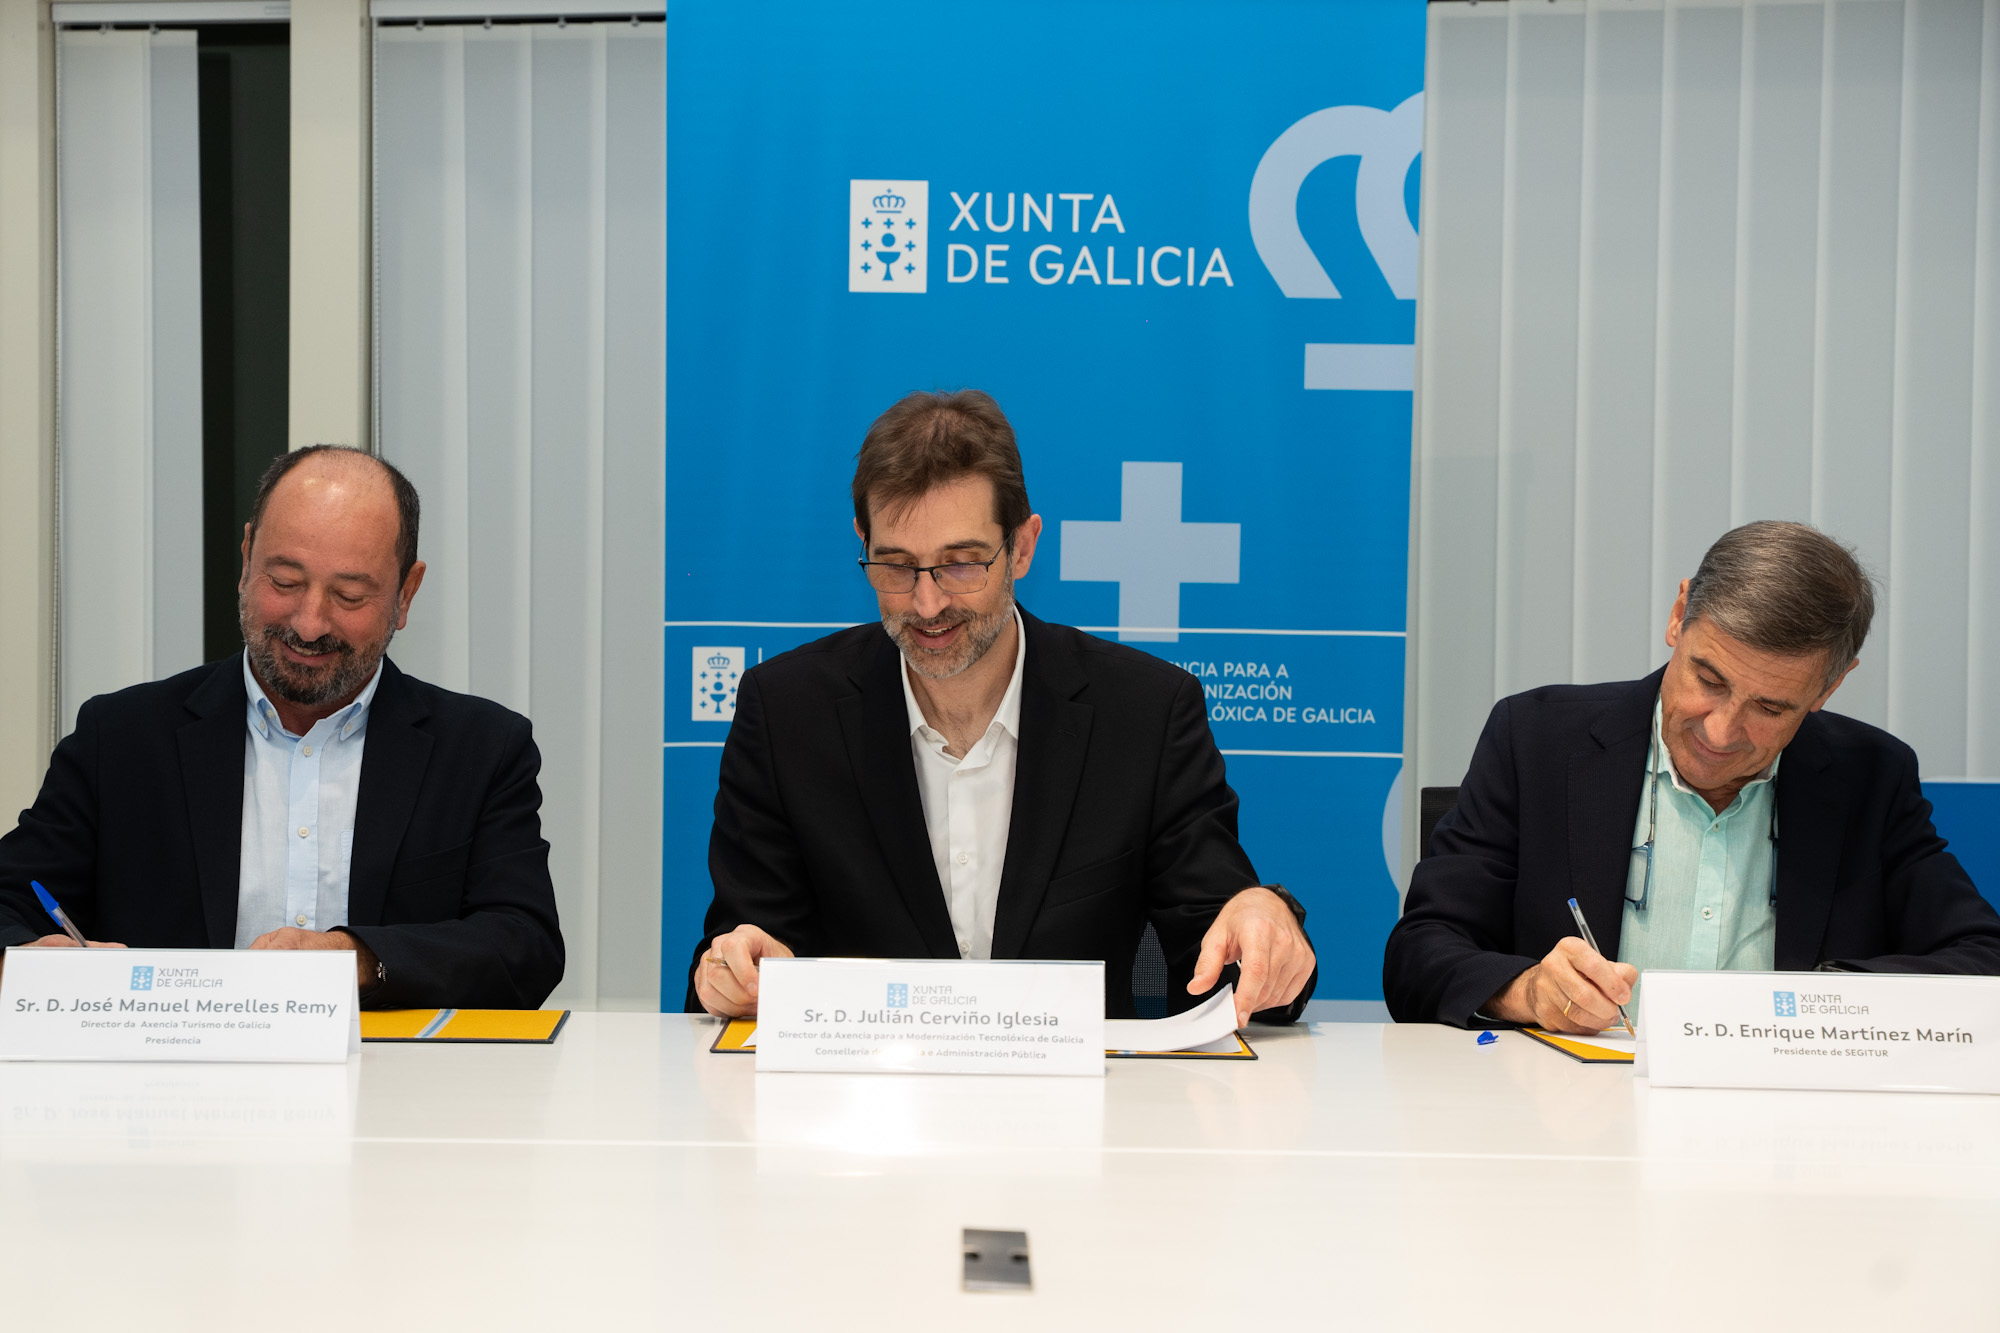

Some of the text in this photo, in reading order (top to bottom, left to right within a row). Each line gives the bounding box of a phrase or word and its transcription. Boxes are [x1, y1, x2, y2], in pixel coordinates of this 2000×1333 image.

[948, 191, 1126, 234] XUNTA
[946, 243, 1235, 288] DE GALICIA
[1168, 661, 1289, 678] NCIA PARA A
[1203, 681, 1292, 700] NIZACIÓN
[1272, 706, 1297, 723] DE
[1301, 707, 1376, 724] GALICIA
[158, 968, 199, 978] XUNTA
[156, 978, 223, 989] DE GALICIA
[913, 985, 953, 995] XUNTA
[912, 996, 977, 1005] DE GALICIA
[1800, 993, 1842, 1004] XUNTA
[14, 997, 338, 1017] Sr. D. José Manuel Merelles Remy
[1800, 1003, 1870, 1015] DE GALICIA
[80, 1020, 271, 1030] Director da Axencia Turismo de Galicia
[804, 1008, 1059, 1030] Sr. D. Julián Cerviño Iglesia
[778, 1031, 1084, 1044] Director da Axencia para a Modernización Tecnolóxica de Galicia
[1683, 1022, 1974, 1044] Sr. D. Enrique Martínez Marín
[145, 1036, 201, 1045] Presidencia
[928, 1049, 934, 1057] e
[935, 1048, 1009, 1059] Administración
[1011, 1049, 1047, 1059] Pública
[1773, 1046, 1889, 1058] Presidente de SEGITUR
